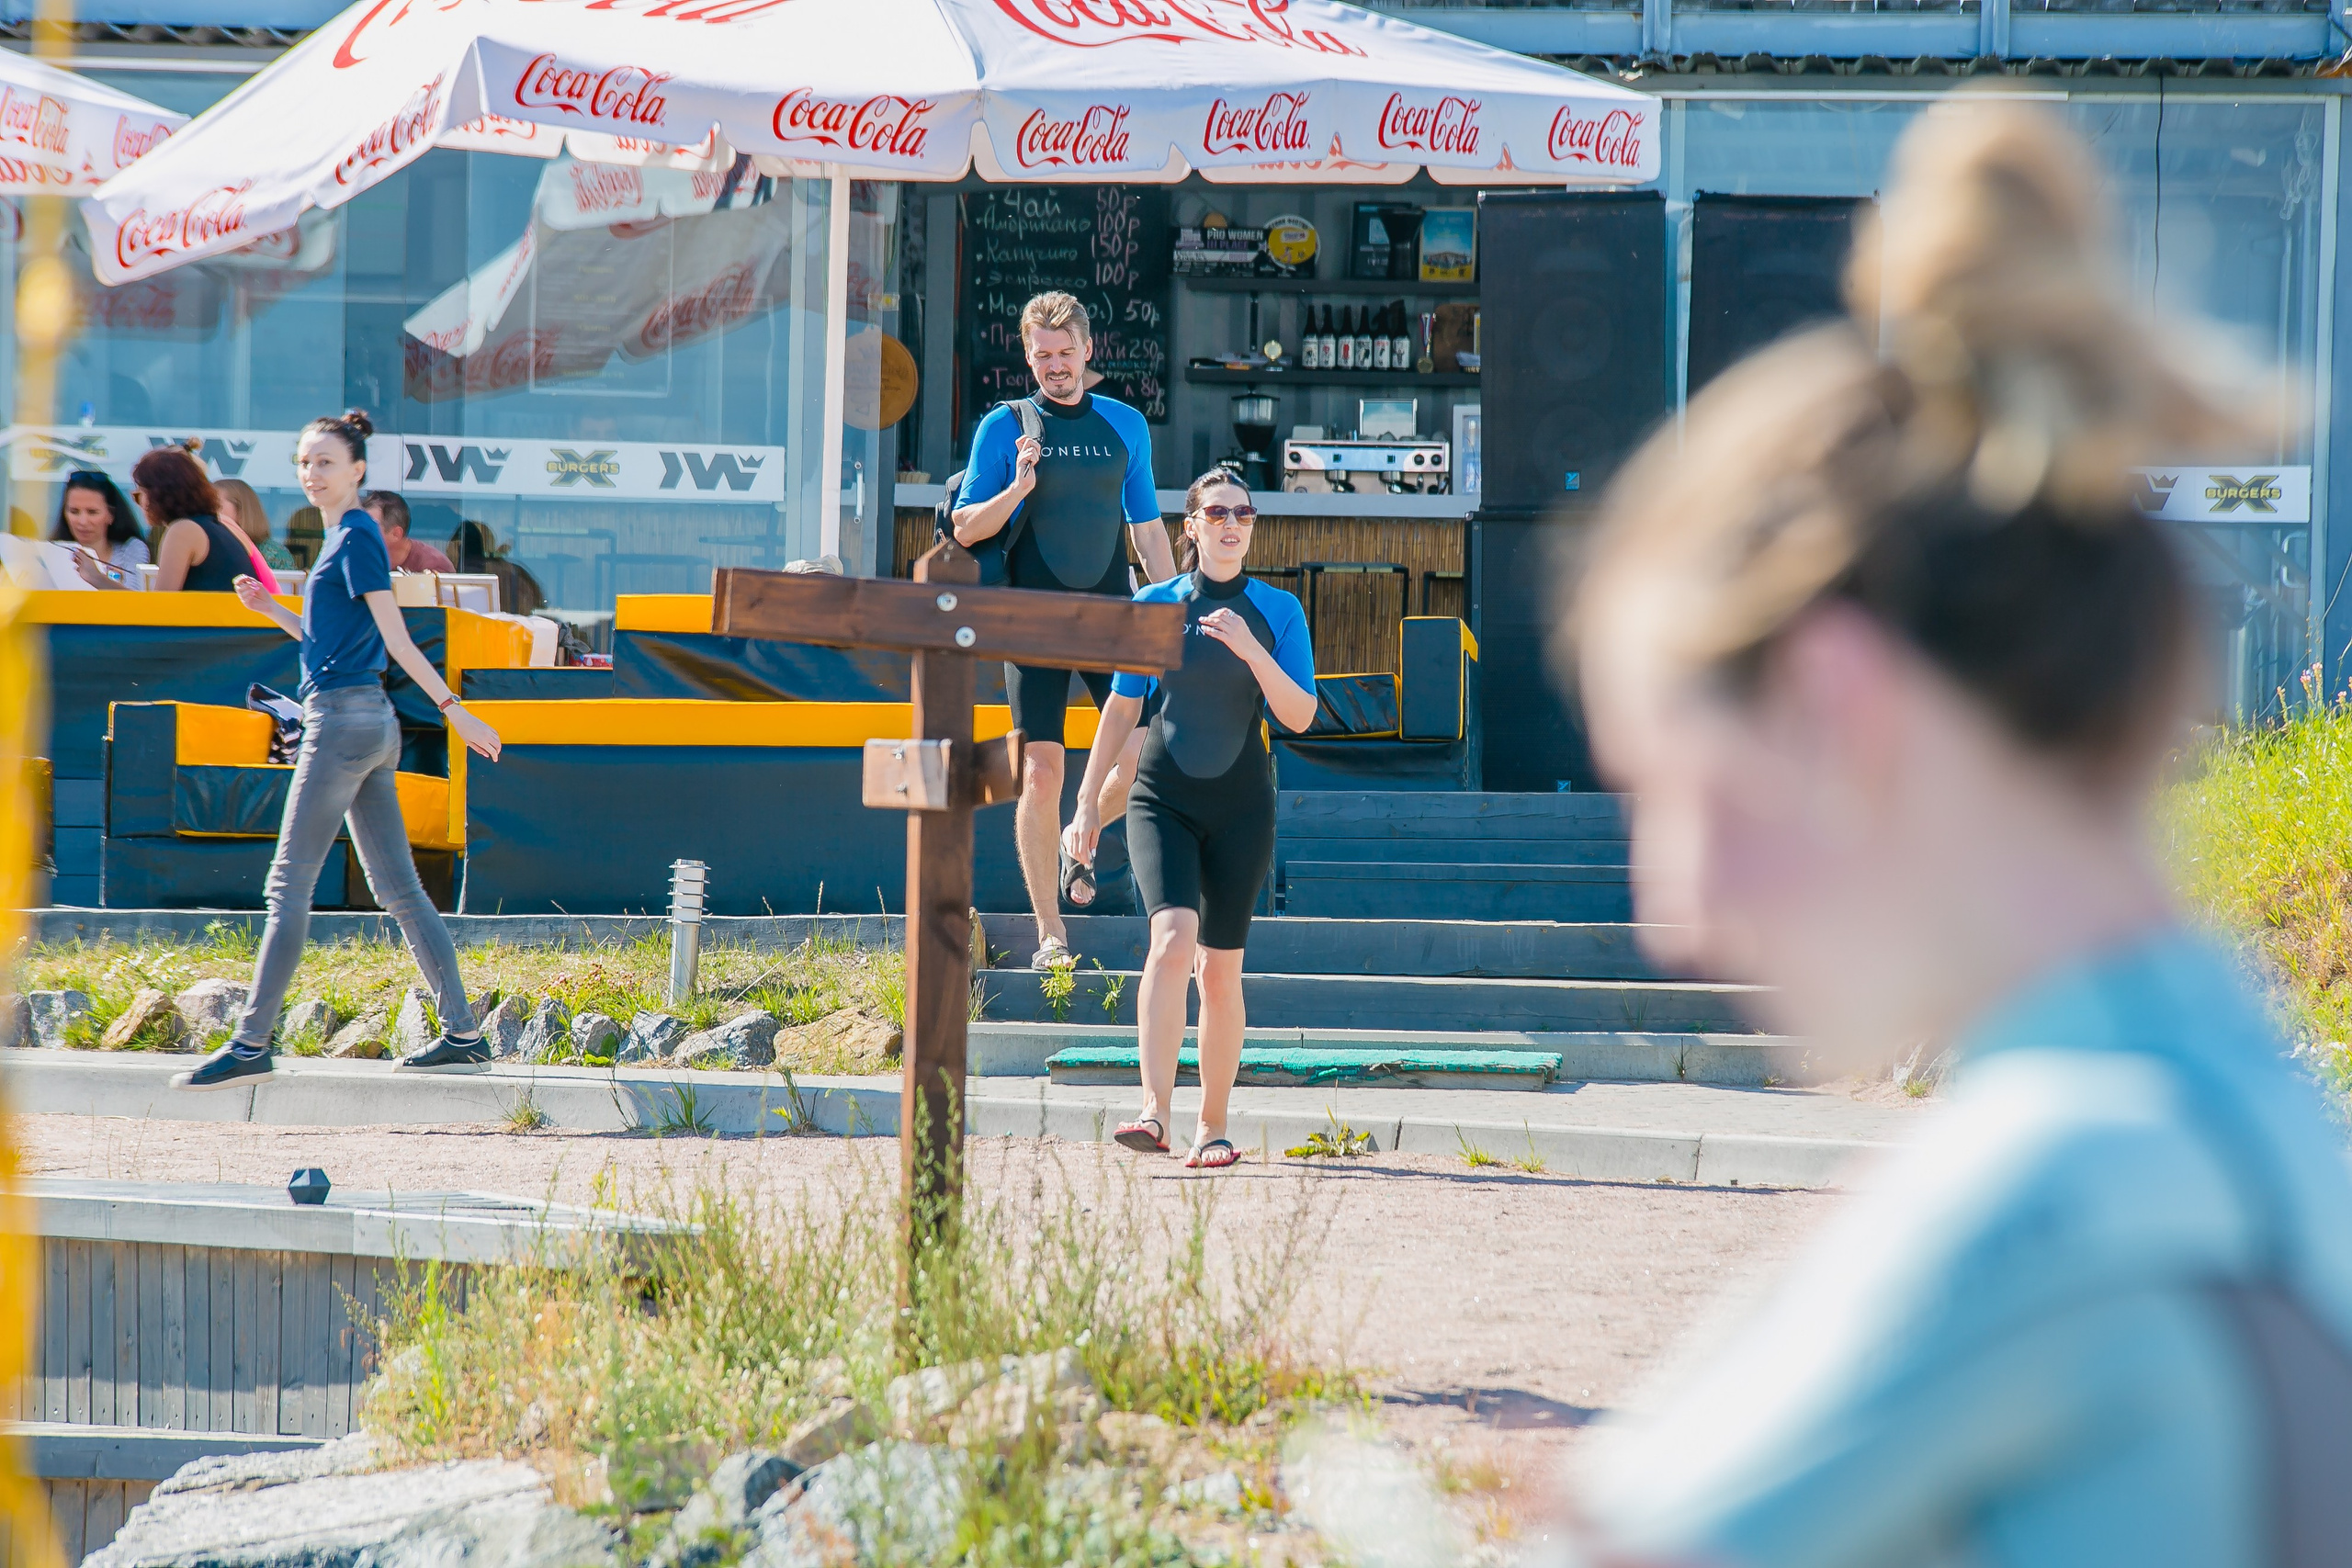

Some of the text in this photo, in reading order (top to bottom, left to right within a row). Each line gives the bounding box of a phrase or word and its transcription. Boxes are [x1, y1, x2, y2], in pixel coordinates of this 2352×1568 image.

[1227, 229, 1263, 241] WOMEN
[1040, 446, 1112, 457] O'NEILL
[547, 461, 620, 476] BURGERS
[2205, 487, 2282, 500] BURGERS
